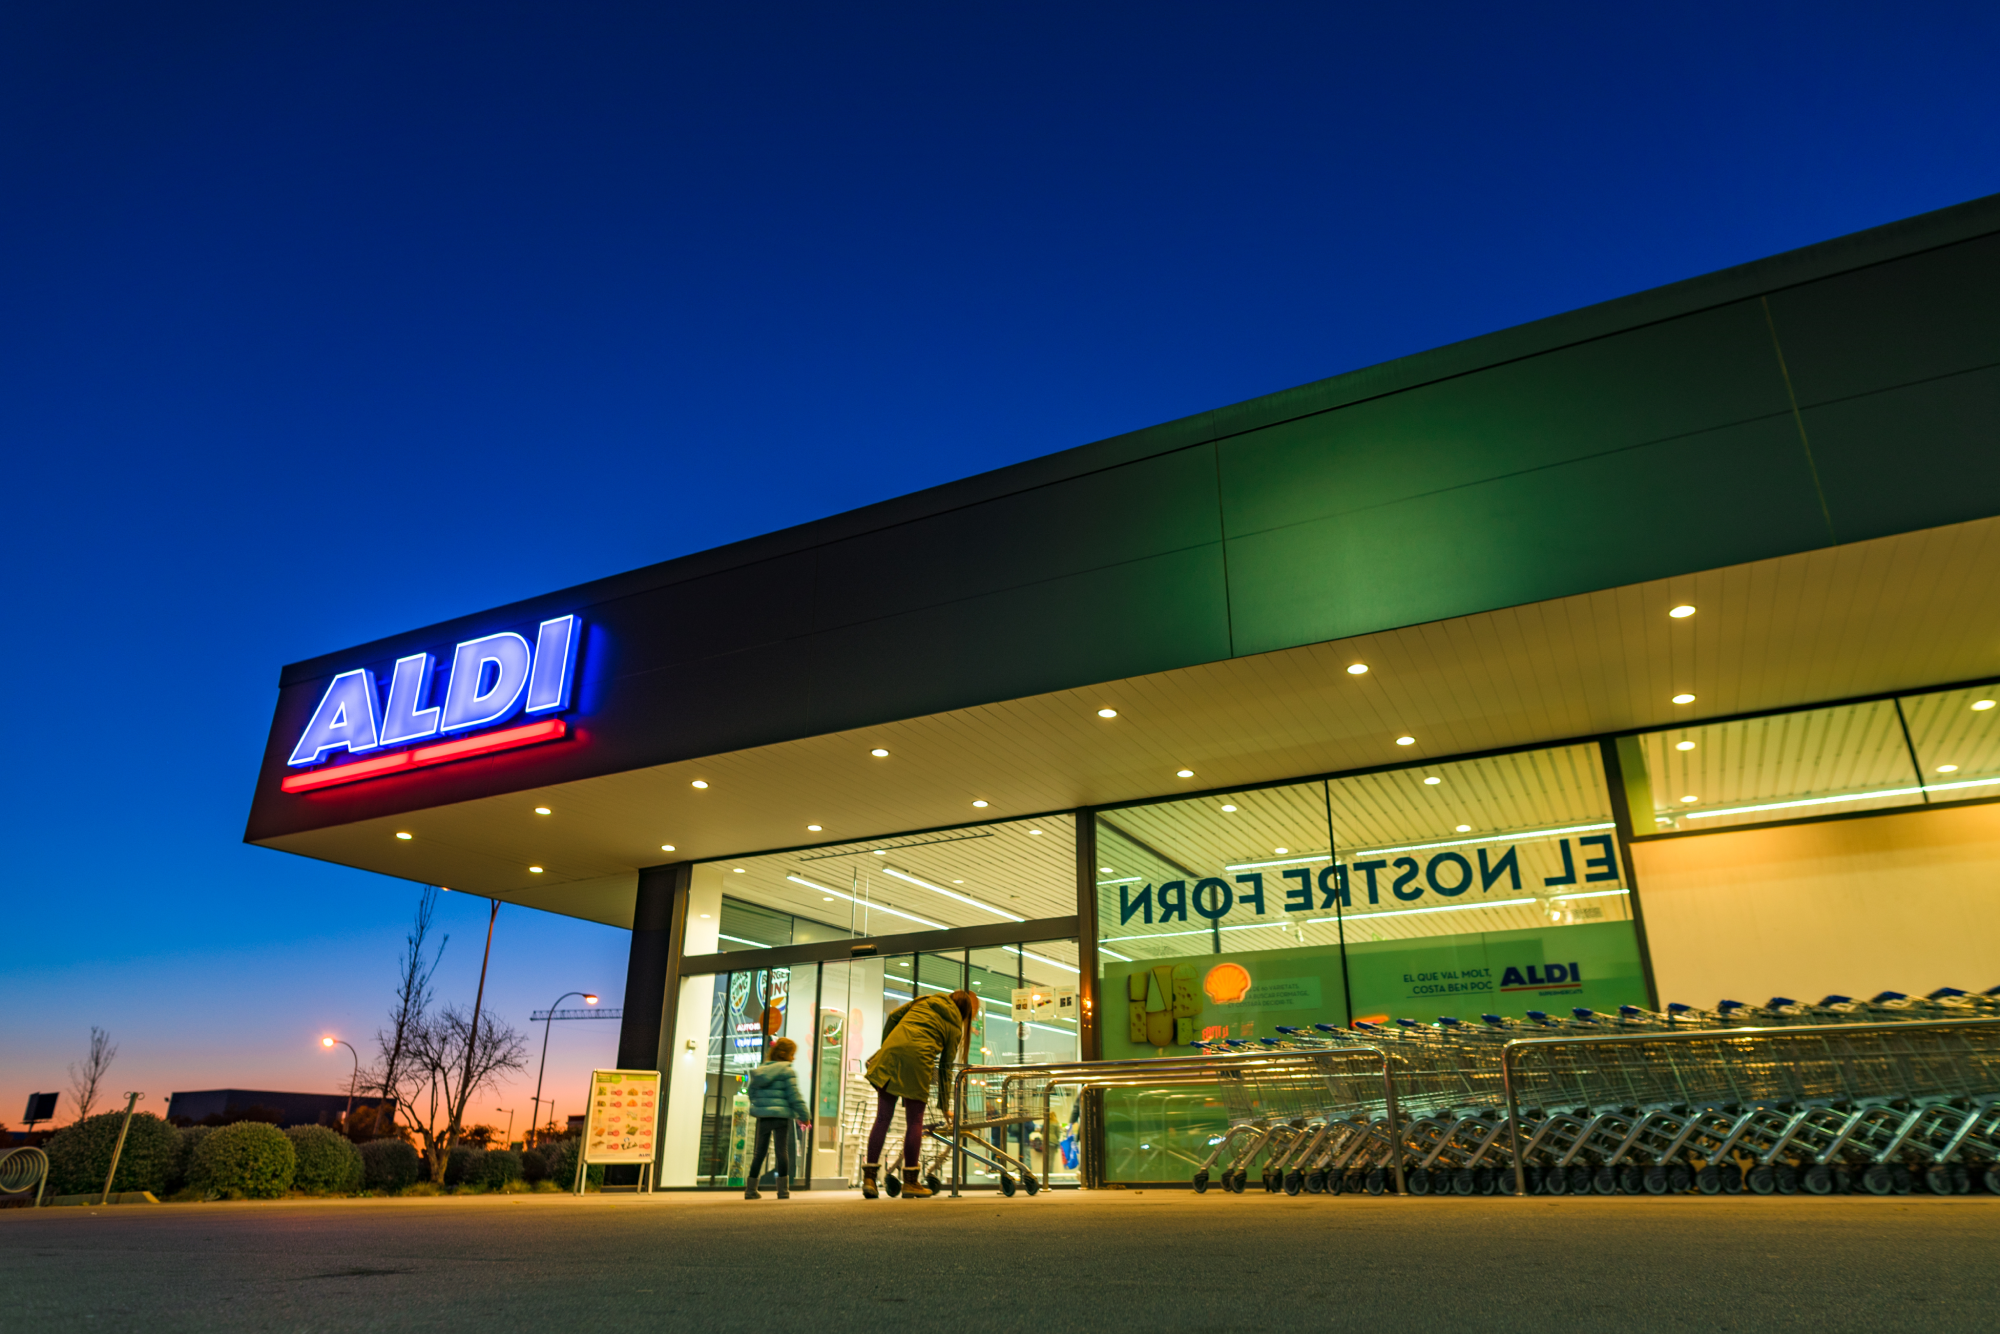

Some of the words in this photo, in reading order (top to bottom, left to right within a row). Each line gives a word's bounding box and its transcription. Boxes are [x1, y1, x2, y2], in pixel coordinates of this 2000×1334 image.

[287, 614, 582, 768] ALDI
[1403, 974, 1415, 983] EL
[1417, 972, 1439, 982] QUE
[1442, 970, 1459, 980] VAL
[1461, 968, 1492, 980] MOLT,
[1499, 962, 1581, 987] ALDI
[1412, 983, 1446, 995] COSTA
[1448, 982, 1469, 992] BEN
[1470, 981, 1494, 991] POC
